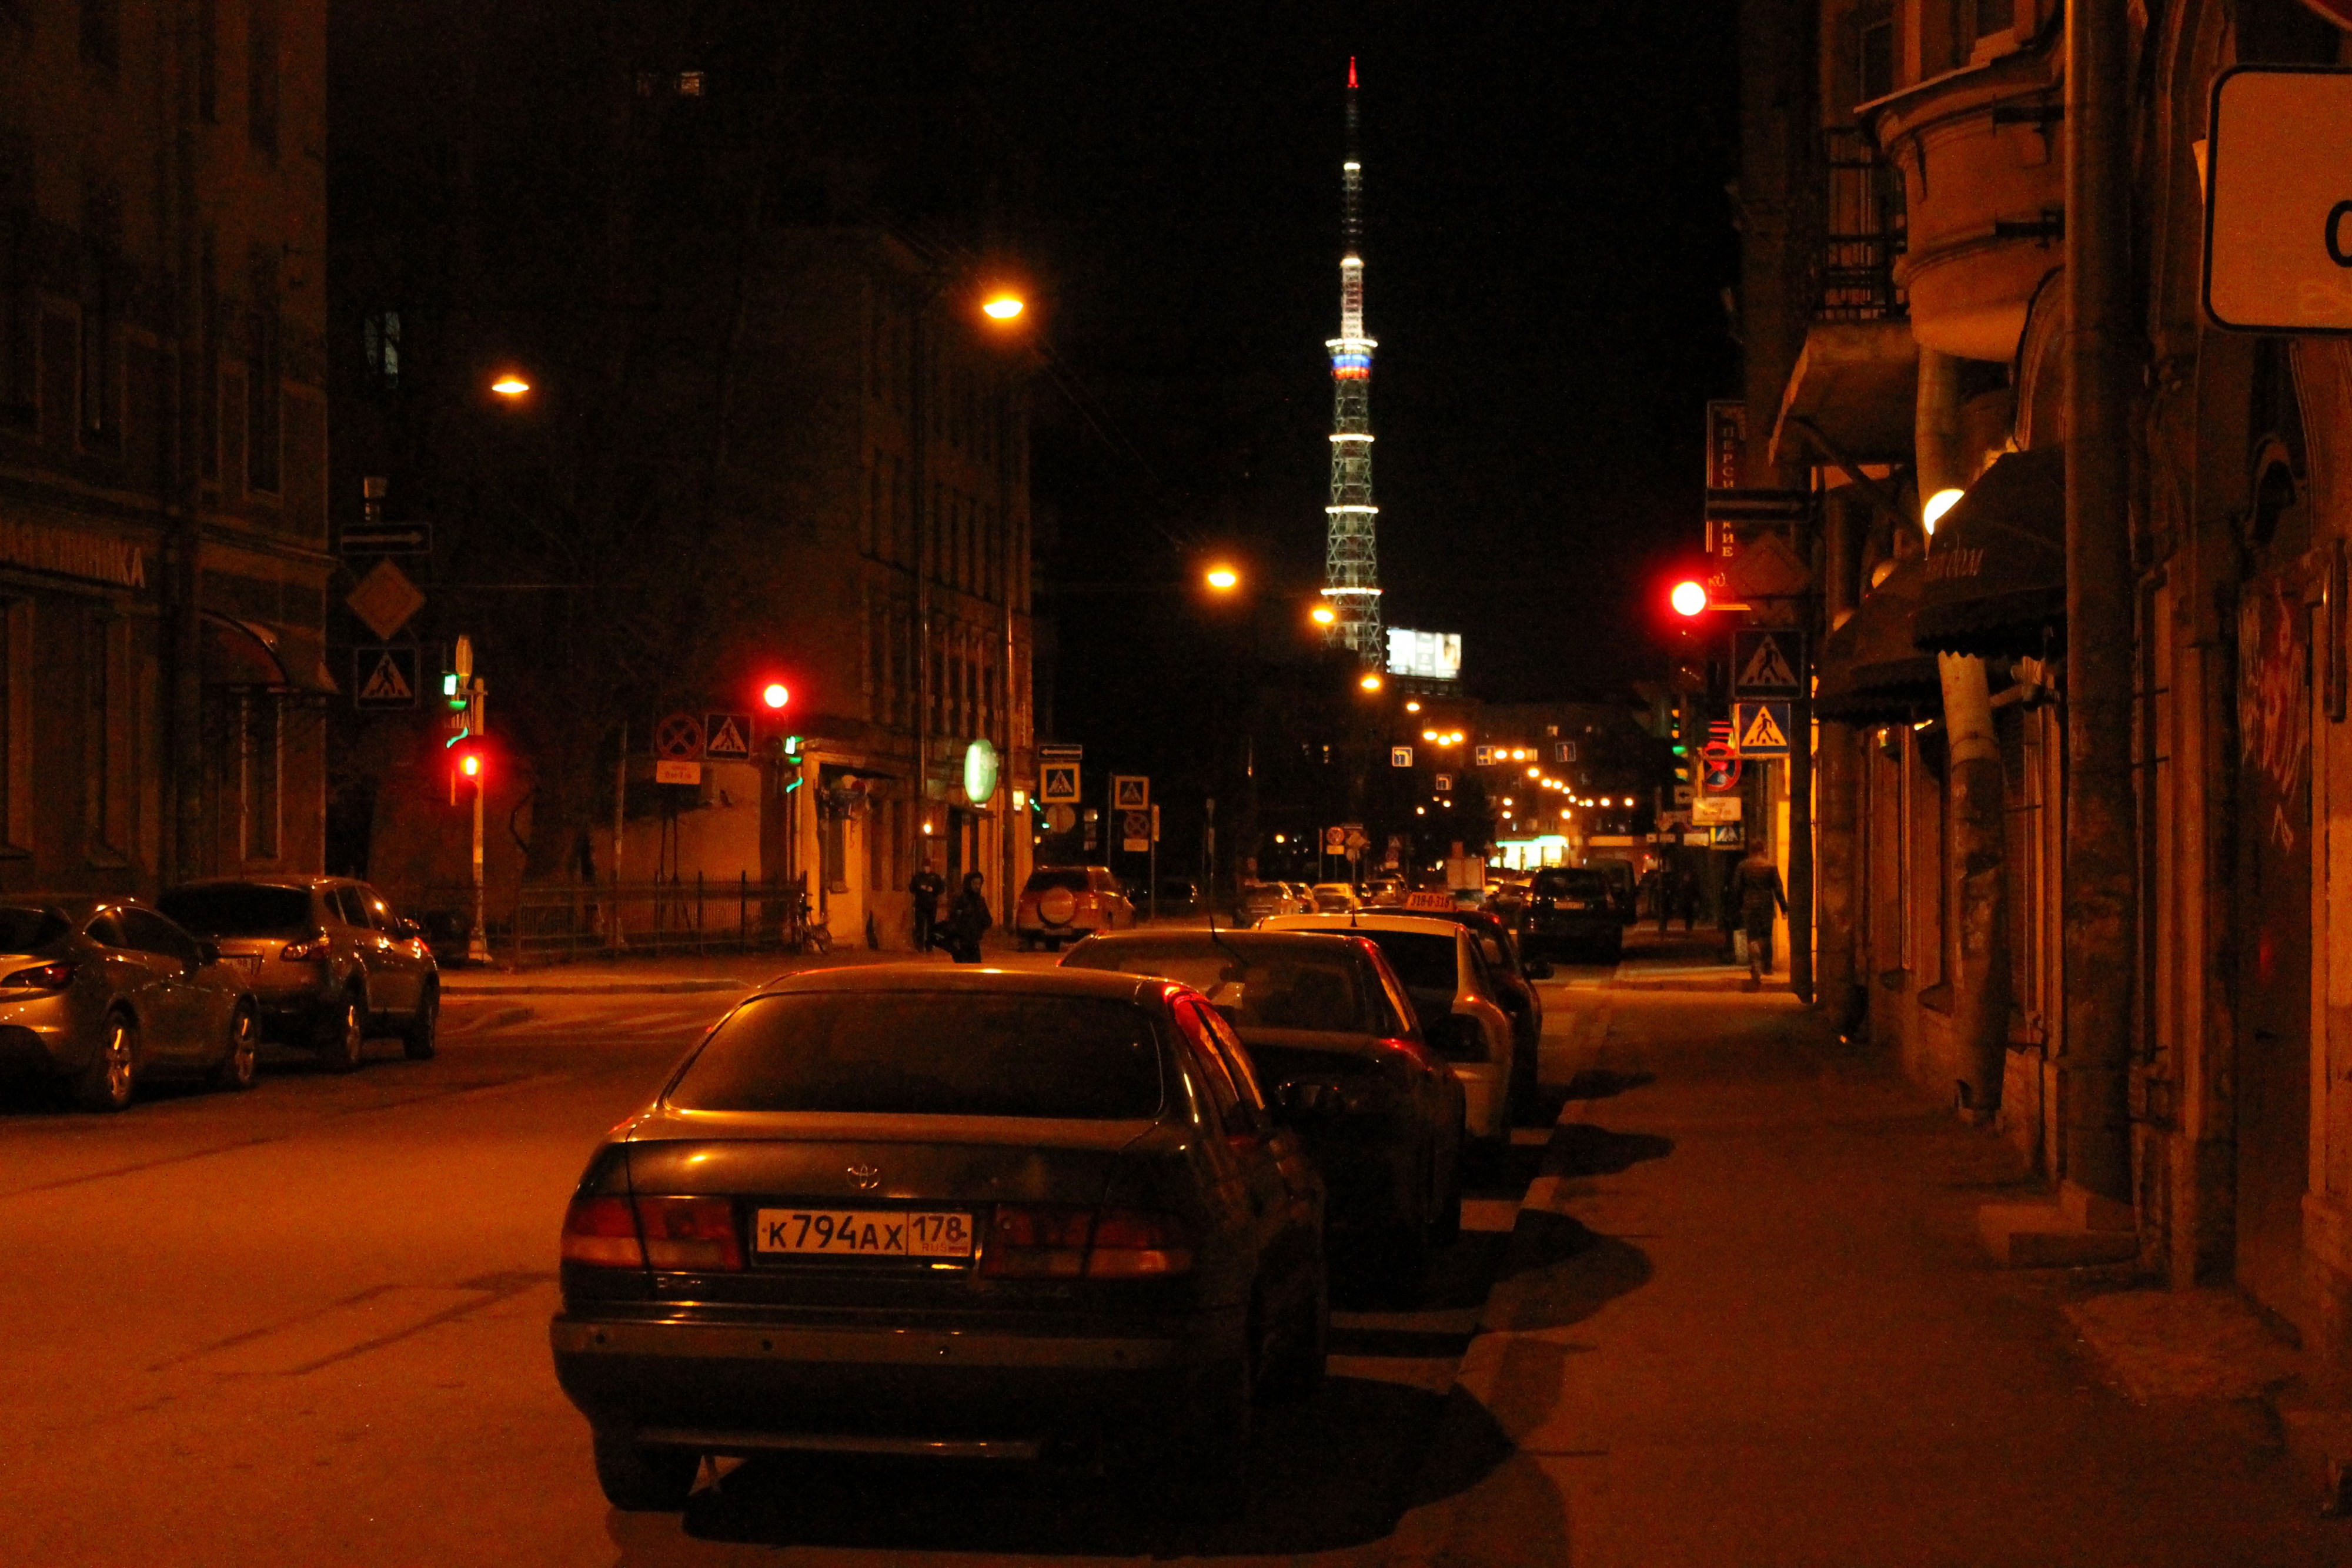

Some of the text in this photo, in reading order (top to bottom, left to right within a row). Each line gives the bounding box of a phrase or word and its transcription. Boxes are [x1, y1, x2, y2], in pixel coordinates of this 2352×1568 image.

[1722, 426, 1734, 557] ПЕРСИКИЕ
[912, 1216, 963, 1243] 178
[922, 1242, 947, 1252] RUS
